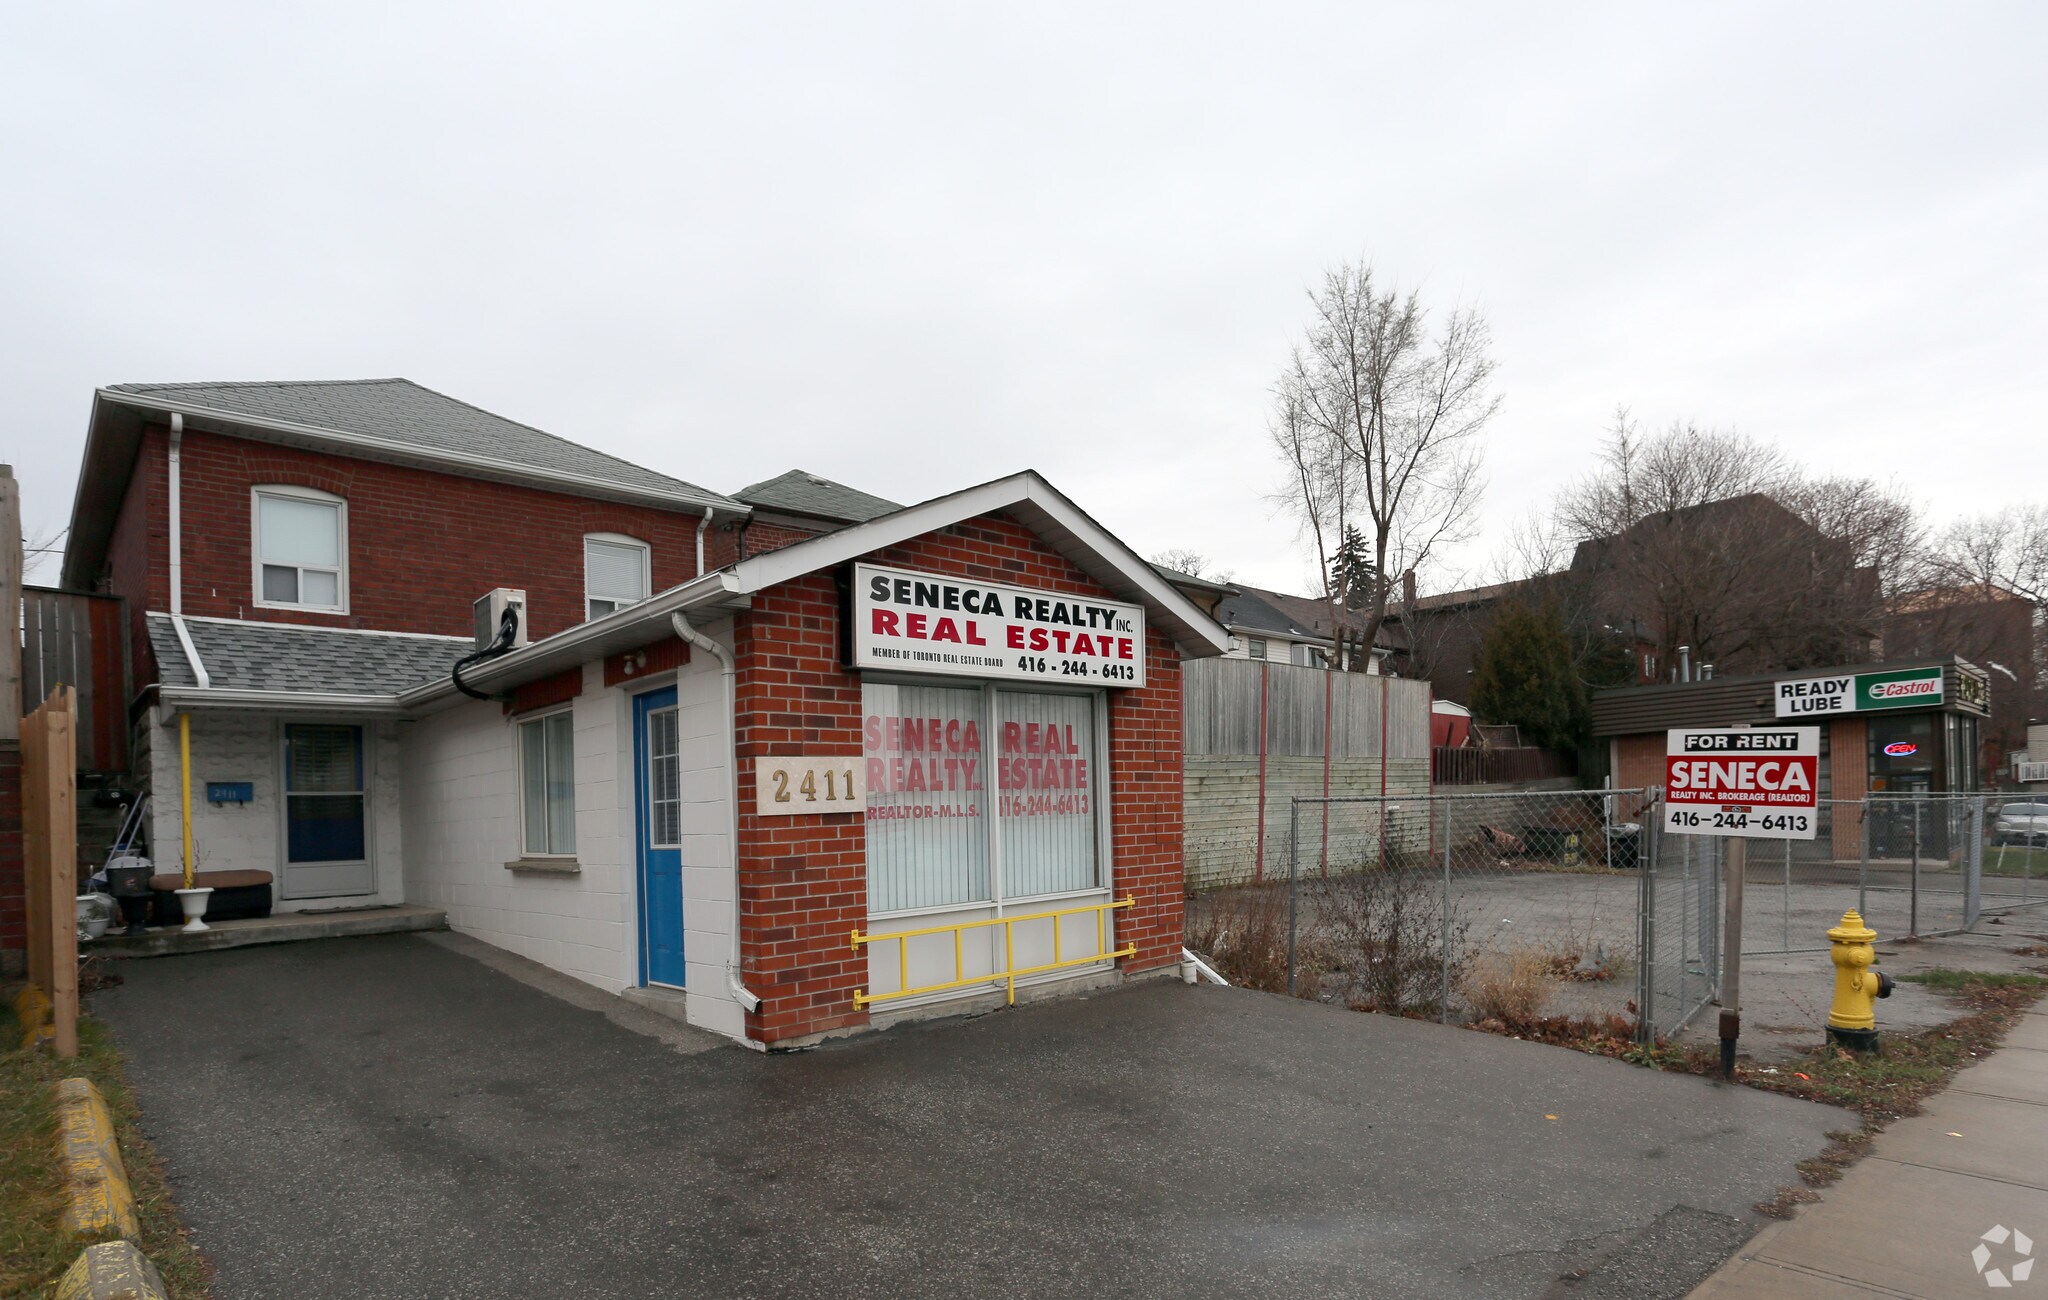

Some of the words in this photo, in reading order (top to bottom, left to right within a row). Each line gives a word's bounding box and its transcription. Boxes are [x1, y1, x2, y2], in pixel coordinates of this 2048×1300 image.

[870, 576, 1004, 617] SENECA
[1015, 596, 1117, 630] REALTY
[1116, 618, 1133, 633] INC.
[872, 608, 986, 646] REAL
[1007, 625, 1133, 659] ESTATE
[872, 647, 900, 659] MEMBER
[903, 650, 911, 660] OF
[913, 651, 941, 662] TORONTO
[943, 653, 958, 664] REAL
[961, 655, 982, 666] ESTATE
[984, 657, 1003, 667] BOARD
[1781, 679, 1850, 698] READY
[1886, 680, 1935, 696] Castrol
[1791, 696, 1842, 712] LUBE
[866, 715, 980, 753] SENECA
[1004, 721, 1078, 754] REAL
[1687, 736, 1728, 749] FOR
[1736, 735, 1796, 748] RENT
[1887, 744, 1917, 753] OPEN
[772, 769, 855, 802] 2411
[867, 757, 976, 792] REALTY
[998, 757, 1087, 790] ESTATE
[1670, 761, 1811, 791] SENECA
[1671, 791, 1697, 800] REALTY
[1700, 791, 1715, 800] INC.
[1718, 793, 1765, 801] BROKERAGE
[1768, 792, 1810, 803] (REALTOR)
